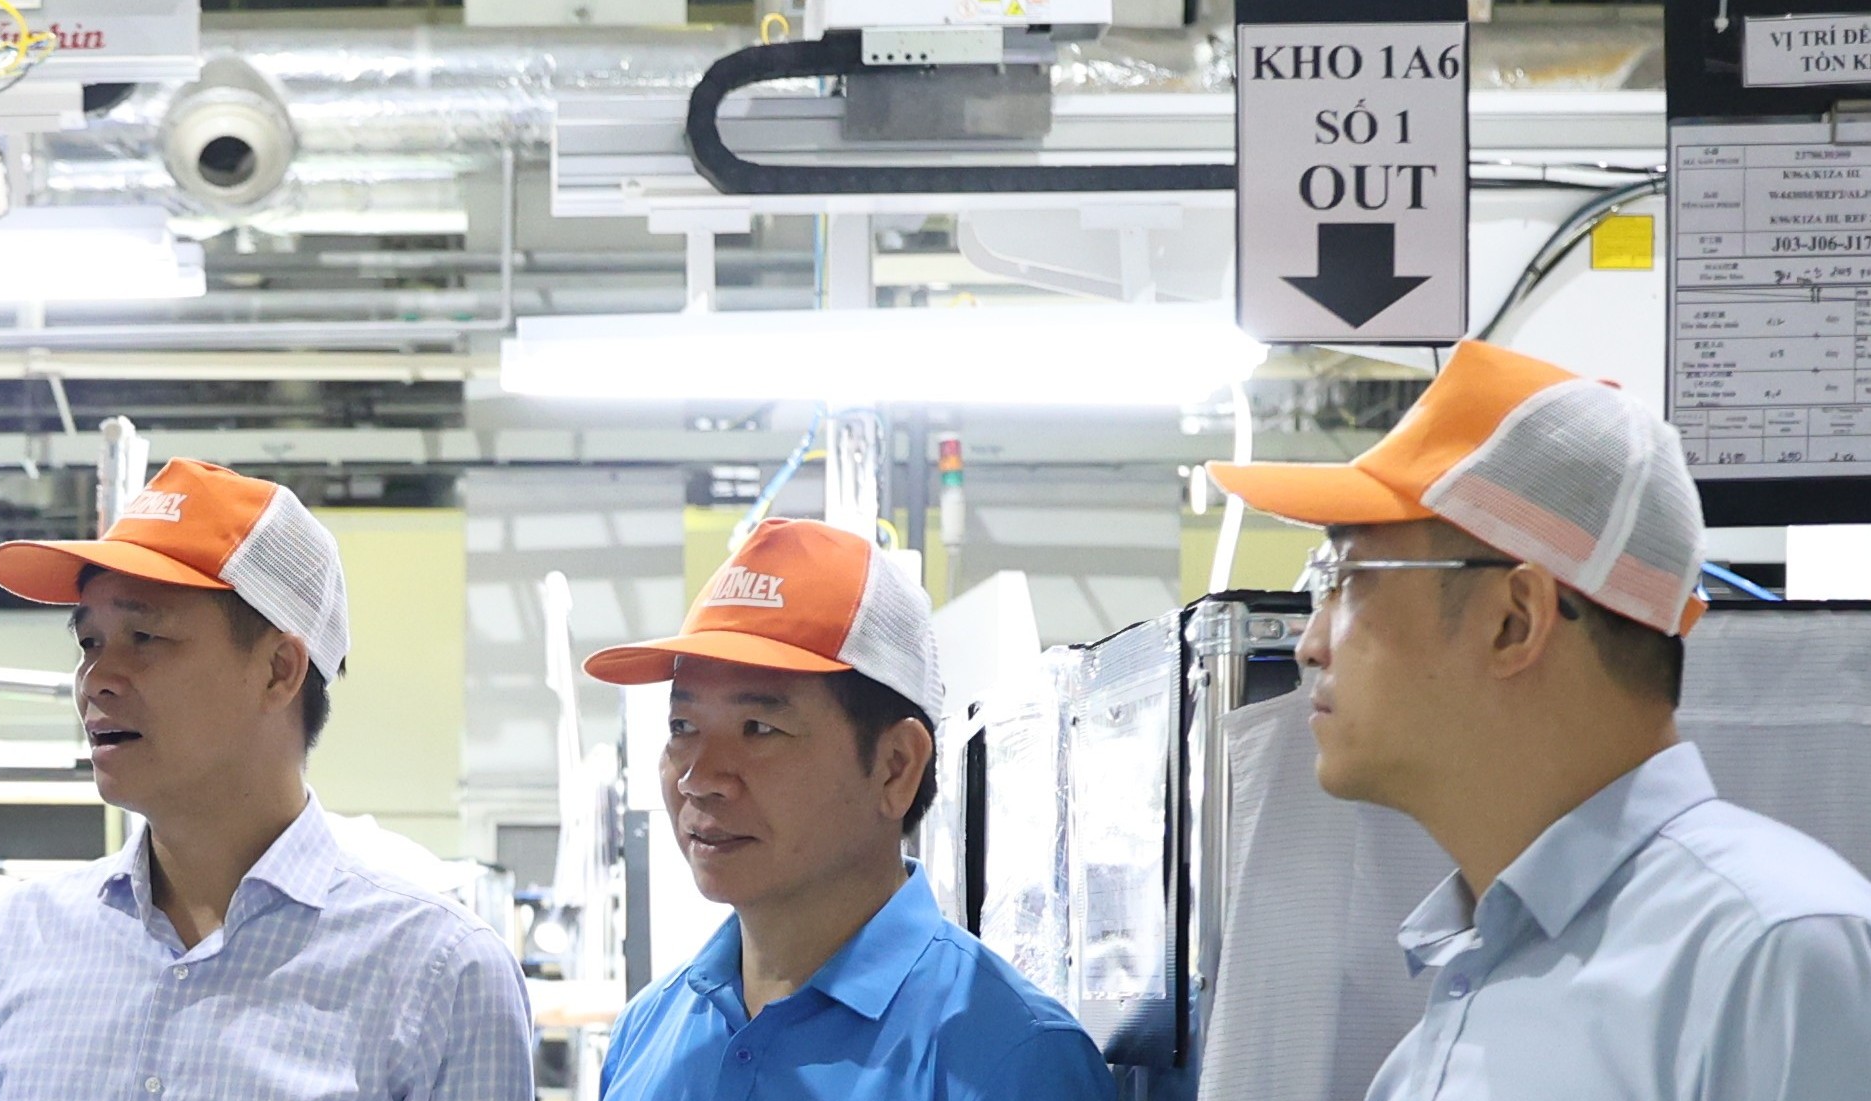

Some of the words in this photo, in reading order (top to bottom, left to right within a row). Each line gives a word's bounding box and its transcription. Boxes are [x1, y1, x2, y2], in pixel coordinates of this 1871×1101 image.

[1799, 25, 1836, 46] TRÍ
[1251, 45, 1363, 80] KHO
[1380, 44, 1460, 80] 1A6
[1853, 54, 1871, 70] K
[1315, 98, 1378, 144] SỐ
[1395, 110, 1411, 144] 1
[1299, 164, 1437, 210] OUT
